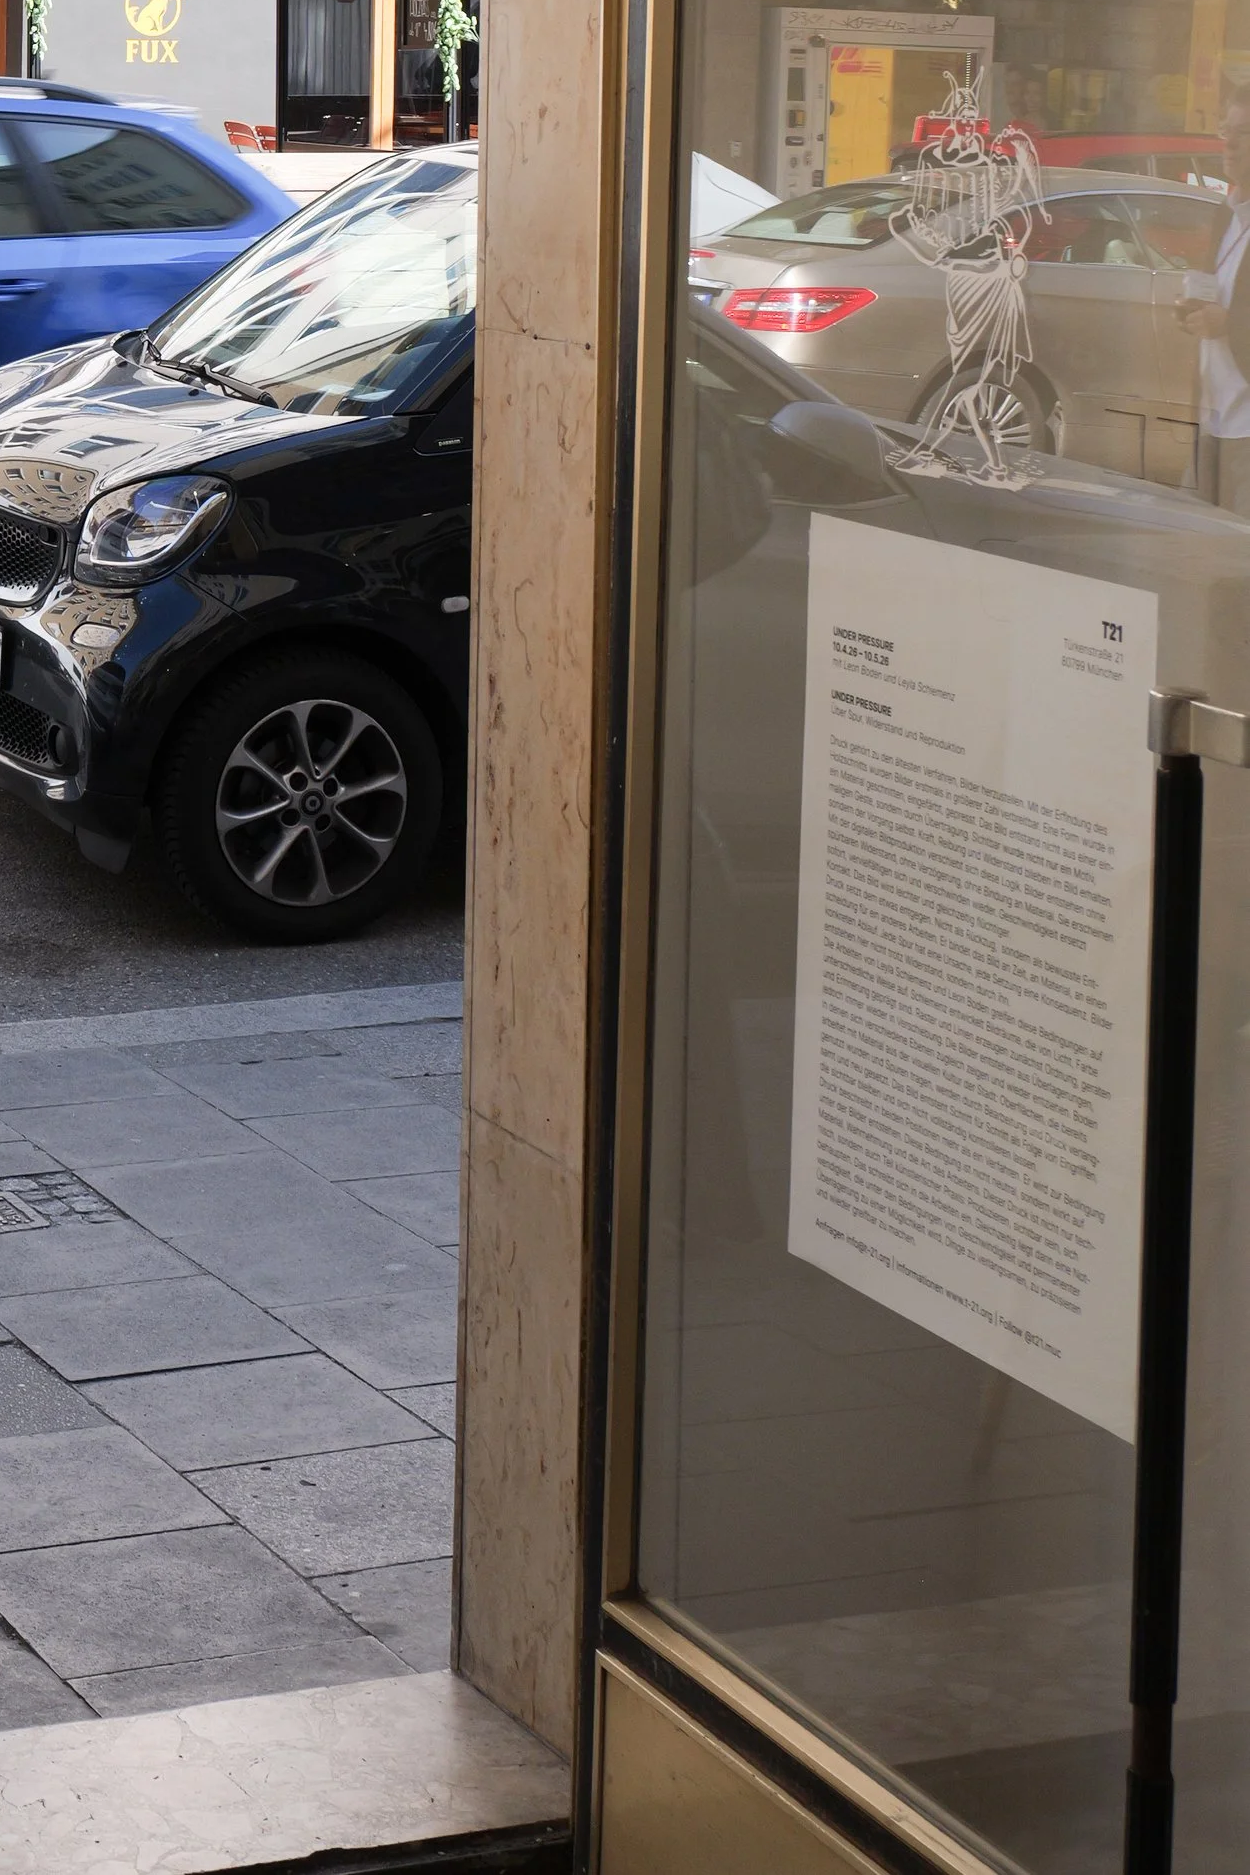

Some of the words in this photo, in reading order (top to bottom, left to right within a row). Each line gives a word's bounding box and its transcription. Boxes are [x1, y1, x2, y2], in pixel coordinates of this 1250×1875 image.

[125, 39, 180, 63] FUX
[832, 625, 857, 642] UNDER
[857, 632, 894, 652] PRESSURE
[1101, 621, 1123, 643] T21
[832, 640, 858, 658] 10.4.26
[863, 649, 889, 667] 10.5.26
[883, 673, 897, 685] und
[830, 688, 855, 705] UNDER
[854, 695, 892, 717] PRESSURE
[904, 729, 918, 741] und
[918, 731, 966, 756] Reproduktion
[814, 1216, 845, 1242] Anfragen
[895, 1260, 944, 1296] Informationen
[998, 1315, 1023, 1338] Follow
